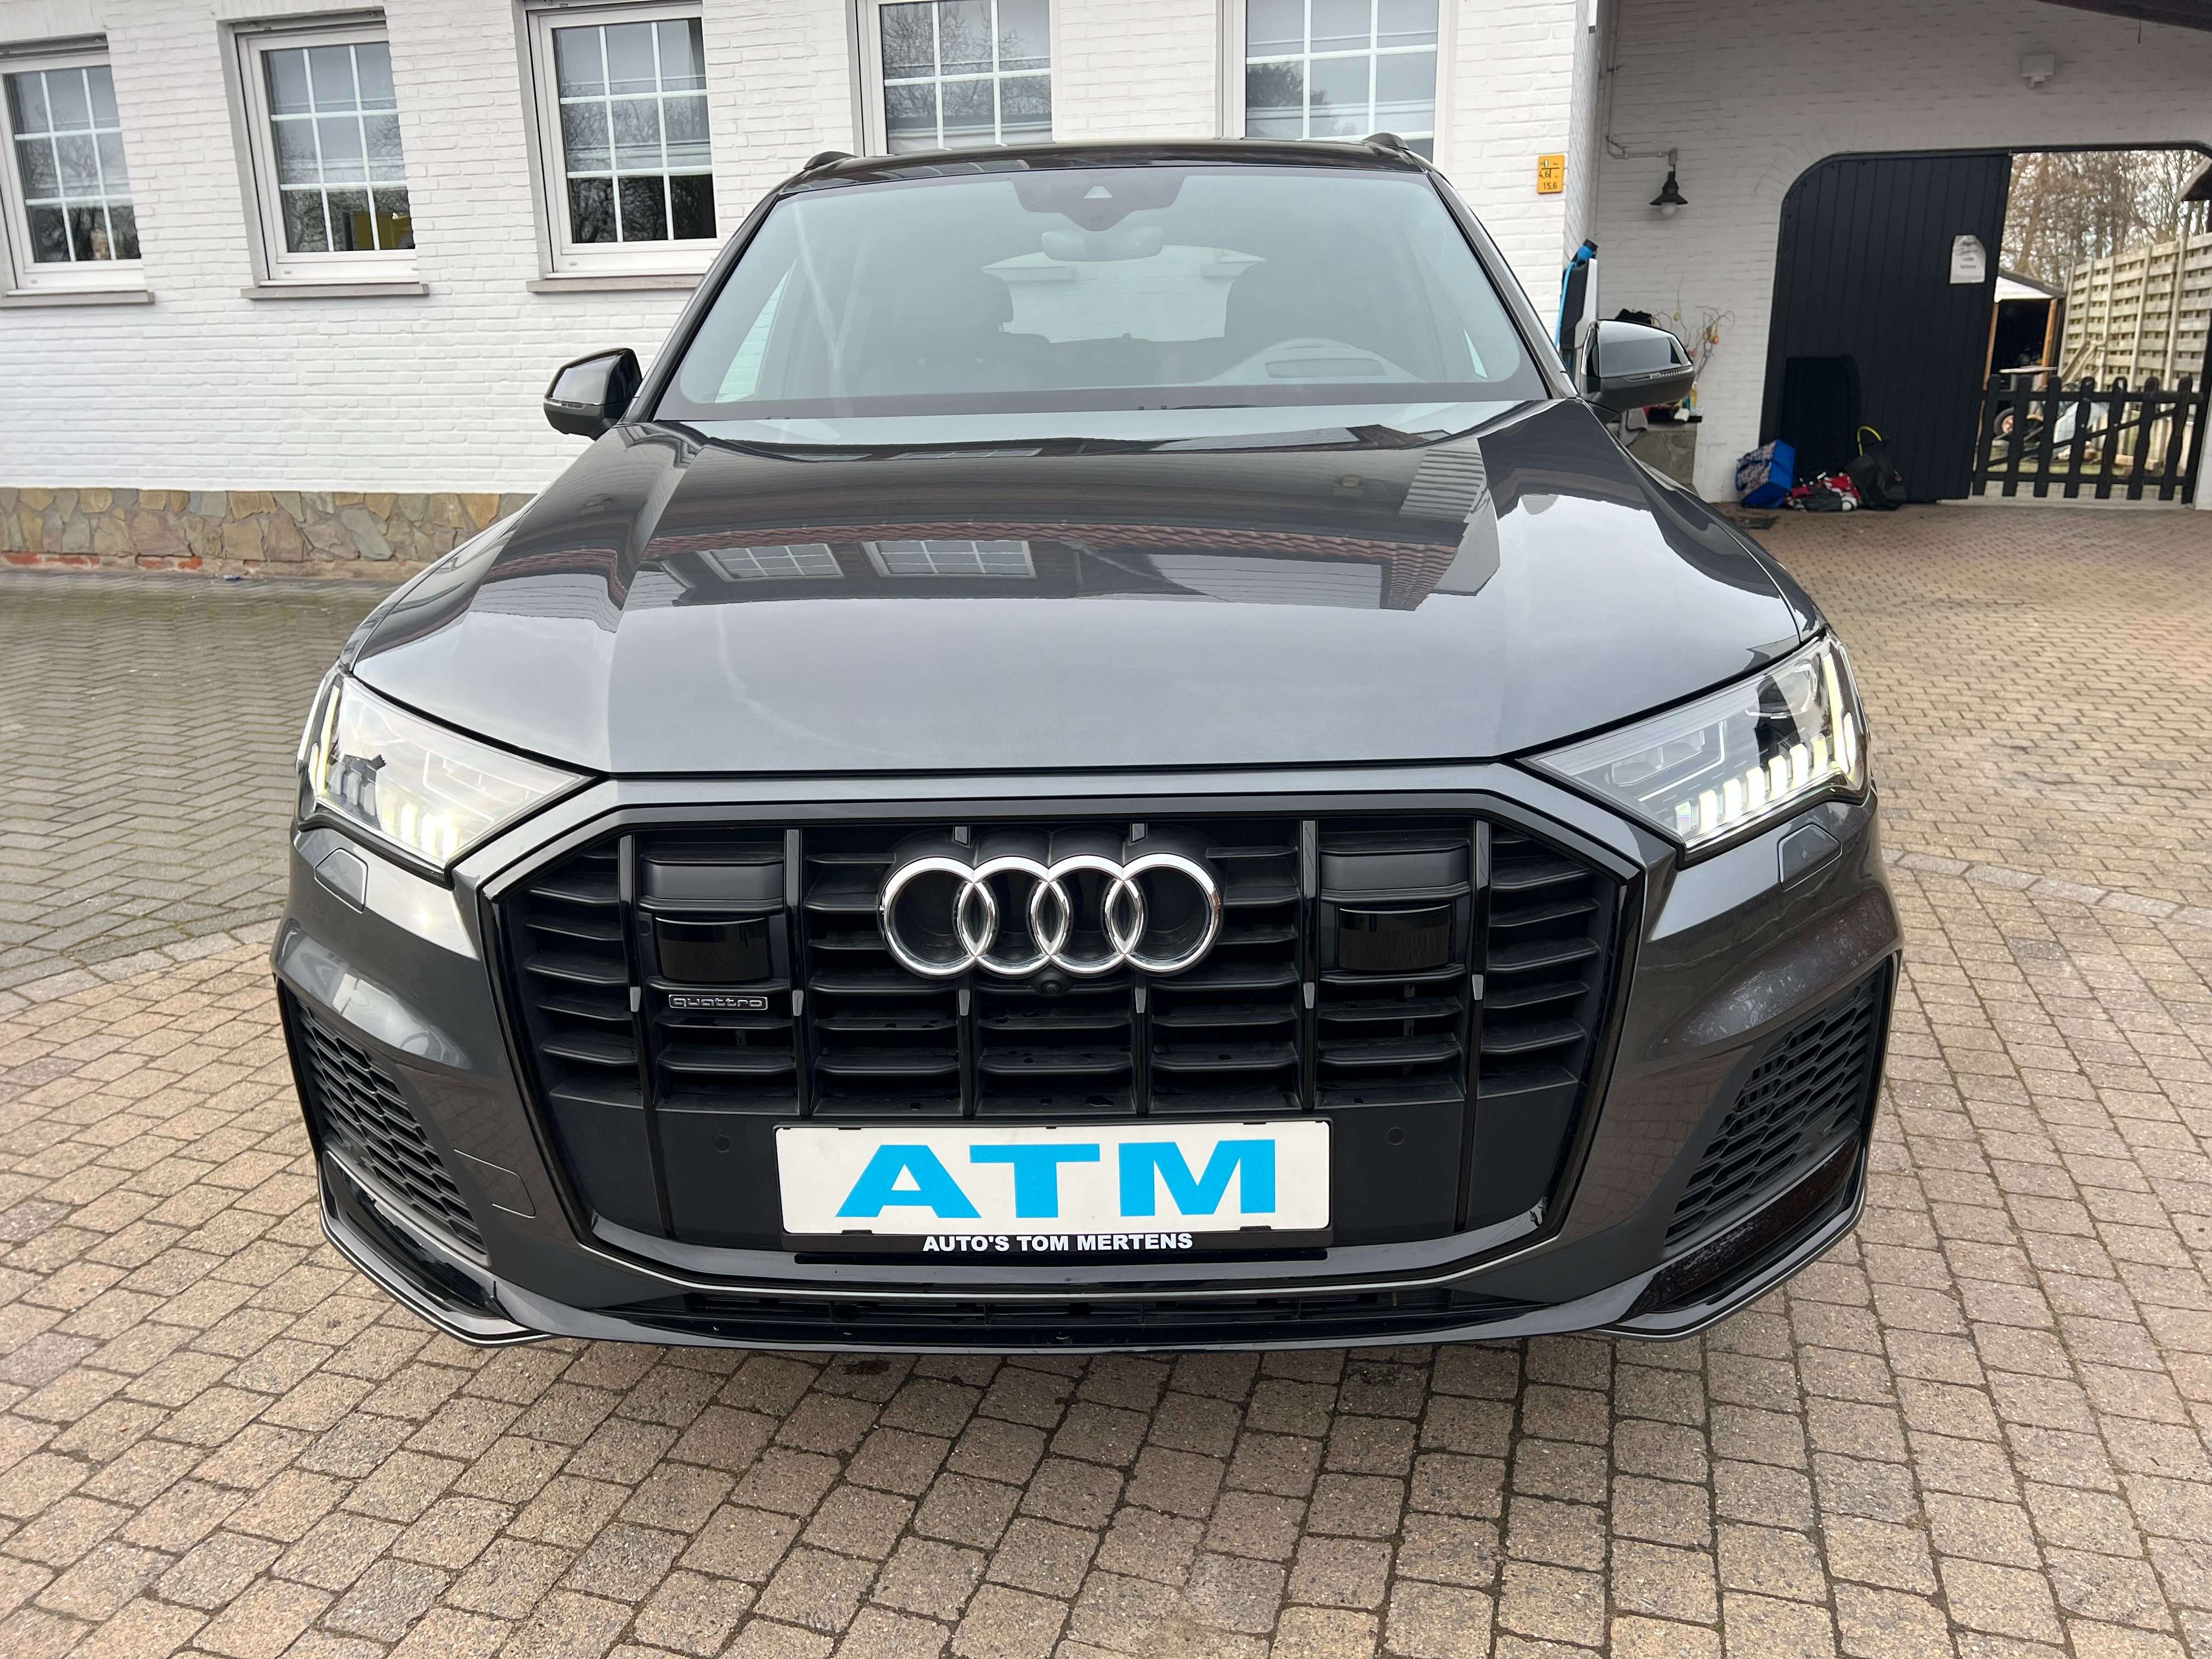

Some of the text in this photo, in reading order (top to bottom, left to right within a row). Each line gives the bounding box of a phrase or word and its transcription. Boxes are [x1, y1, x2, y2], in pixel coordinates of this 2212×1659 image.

[673, 997, 763, 1007] quattro
[834, 1138, 1276, 1219] ATM
[922, 1233, 1193, 1252] AUTO'S TOM MERTENS
